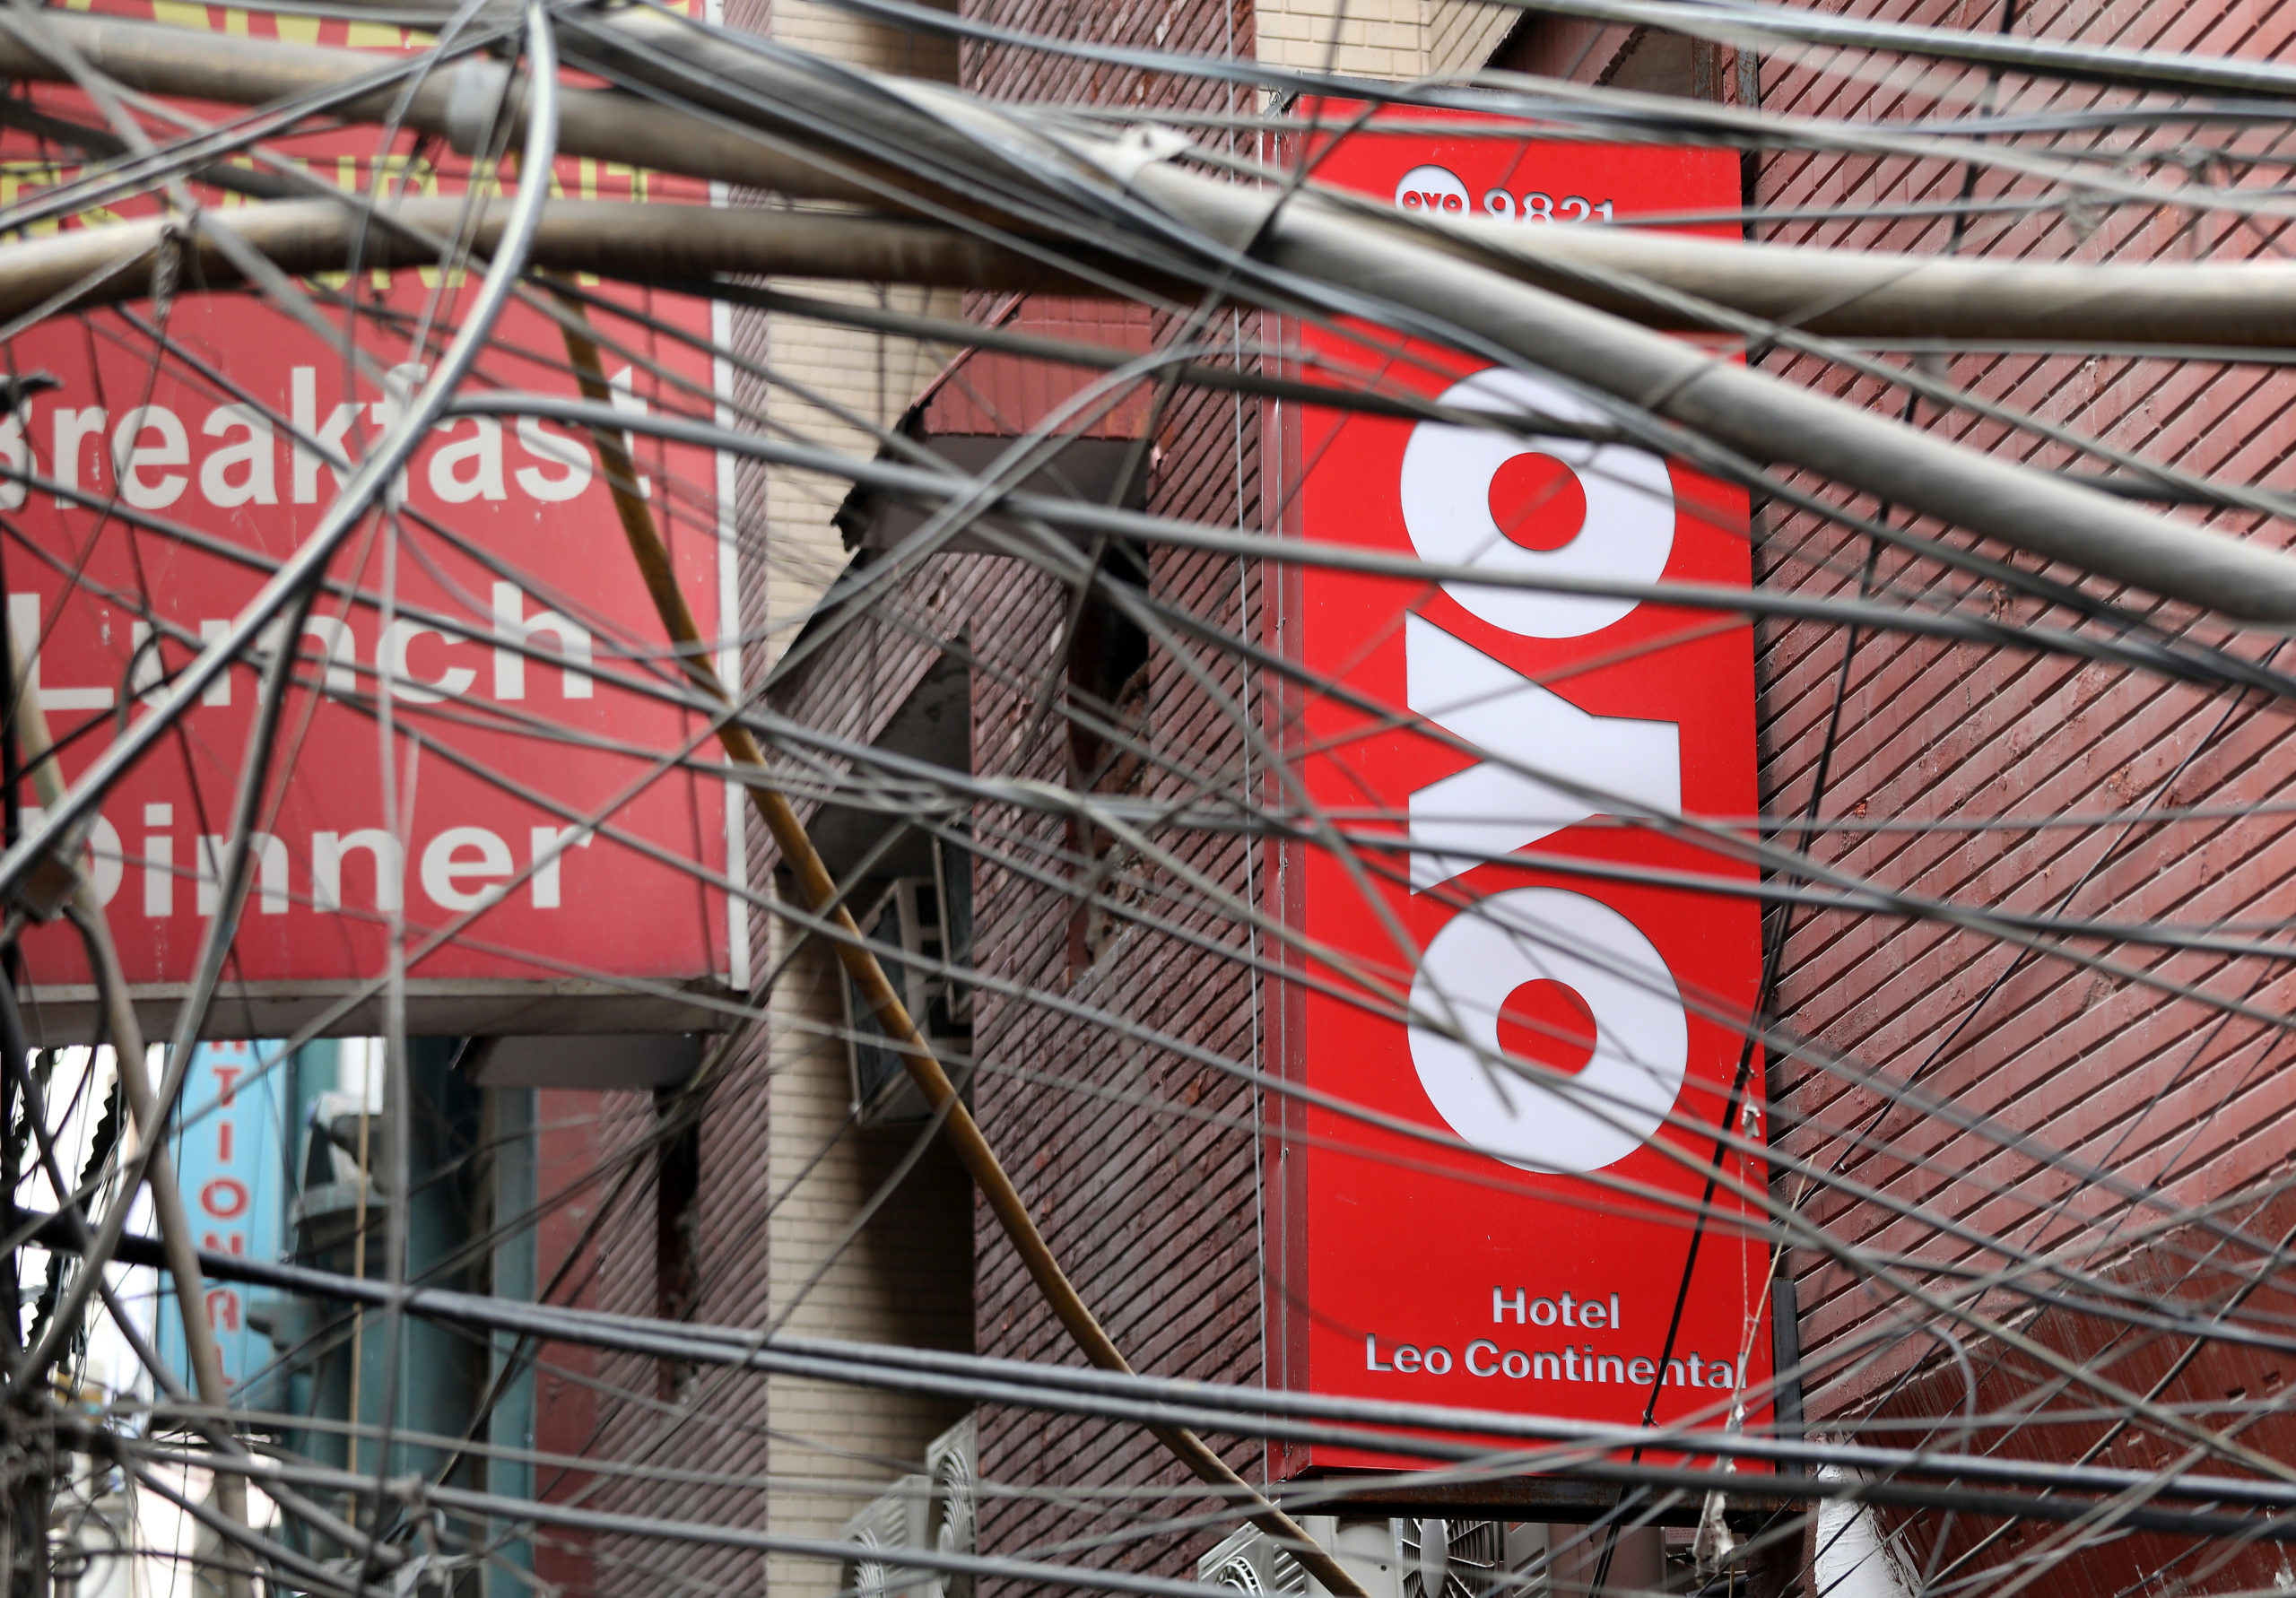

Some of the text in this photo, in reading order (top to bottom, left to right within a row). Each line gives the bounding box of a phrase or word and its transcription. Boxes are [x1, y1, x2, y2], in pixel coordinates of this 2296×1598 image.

[1483, 187, 1613, 225] 9821
[1400, 365, 1689, 1174] OYO
[1492, 1285, 1620, 1329] Hotel
[1366, 1333, 1747, 1389] Leo Continental
